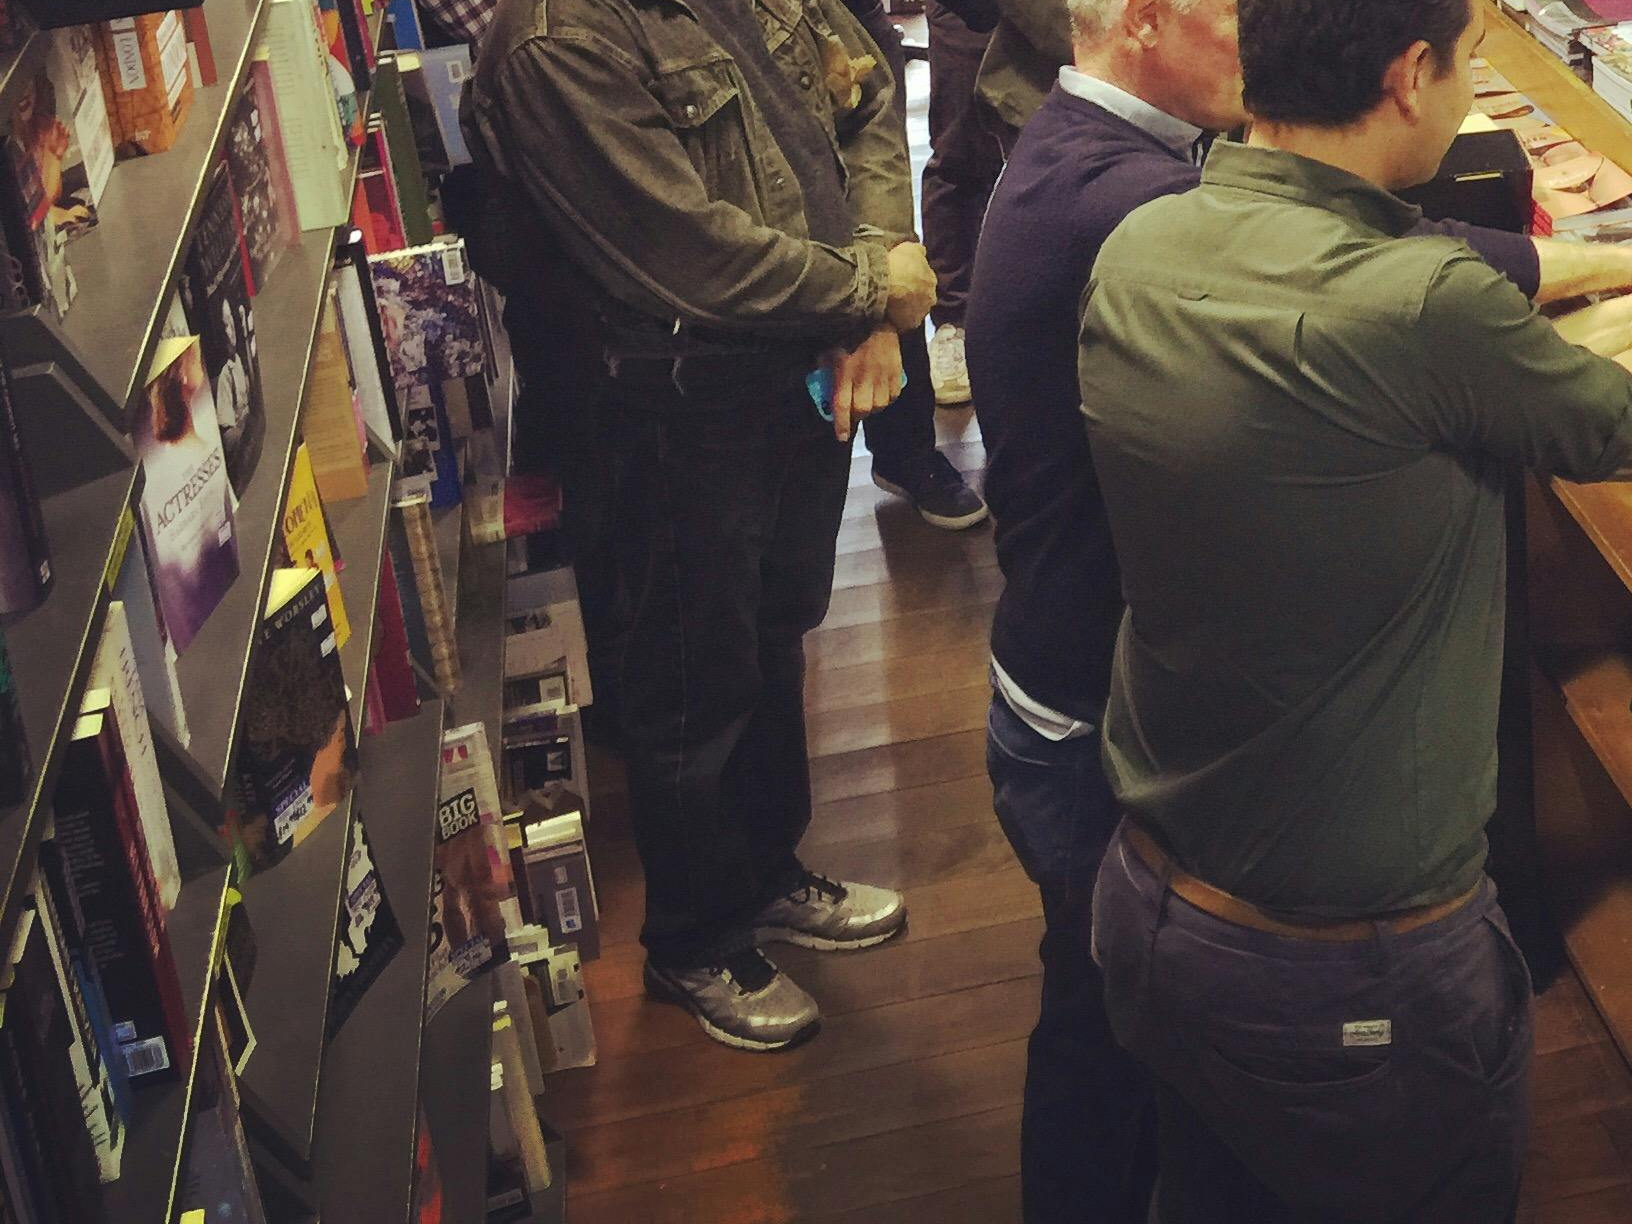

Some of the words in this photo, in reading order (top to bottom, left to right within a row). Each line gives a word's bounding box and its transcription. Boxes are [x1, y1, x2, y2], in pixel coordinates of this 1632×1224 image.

[155, 447, 222, 536] ACTRESSES
[438, 793, 476, 825] BIG
[440, 813, 479, 841] BOOK
